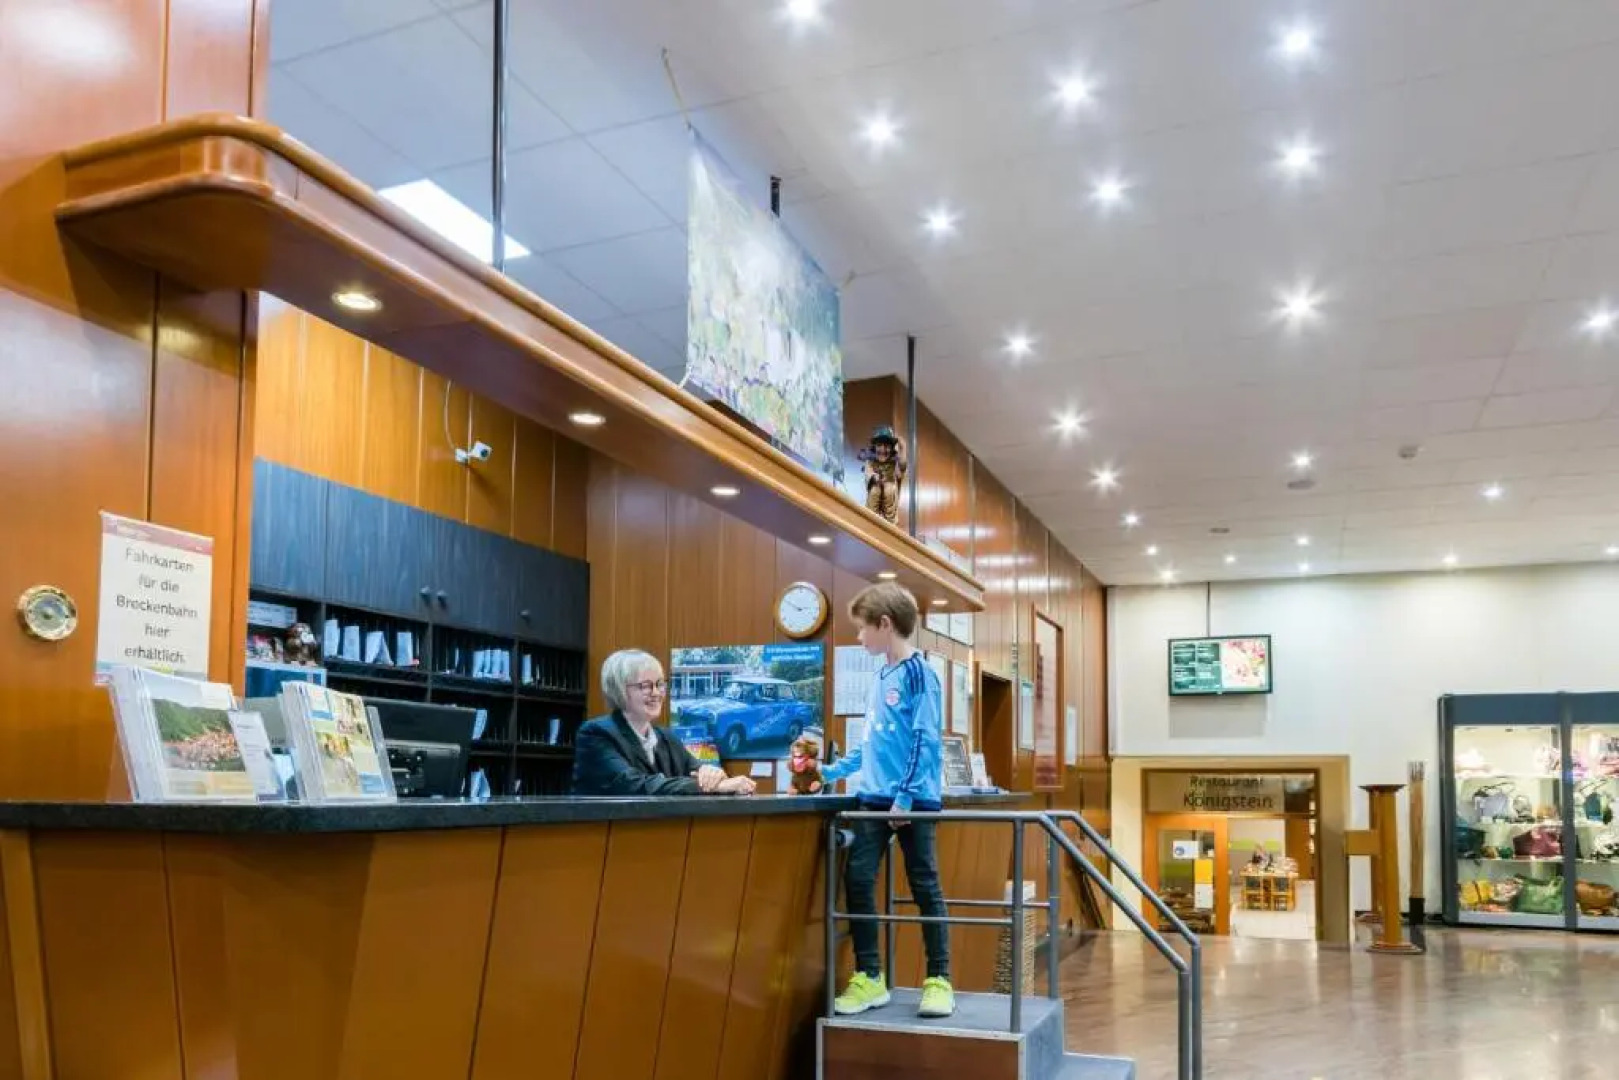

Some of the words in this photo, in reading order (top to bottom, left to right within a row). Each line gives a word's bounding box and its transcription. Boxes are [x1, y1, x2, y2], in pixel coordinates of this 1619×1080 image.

[126, 547, 195, 572] Fahrkarten
[161, 579, 180, 593] die
[116, 594, 198, 618] Brockenbahn
[145, 623, 170, 638] hier
[1190, 776, 1263, 787] Restaurant
[1184, 791, 1273, 809] Königstein
